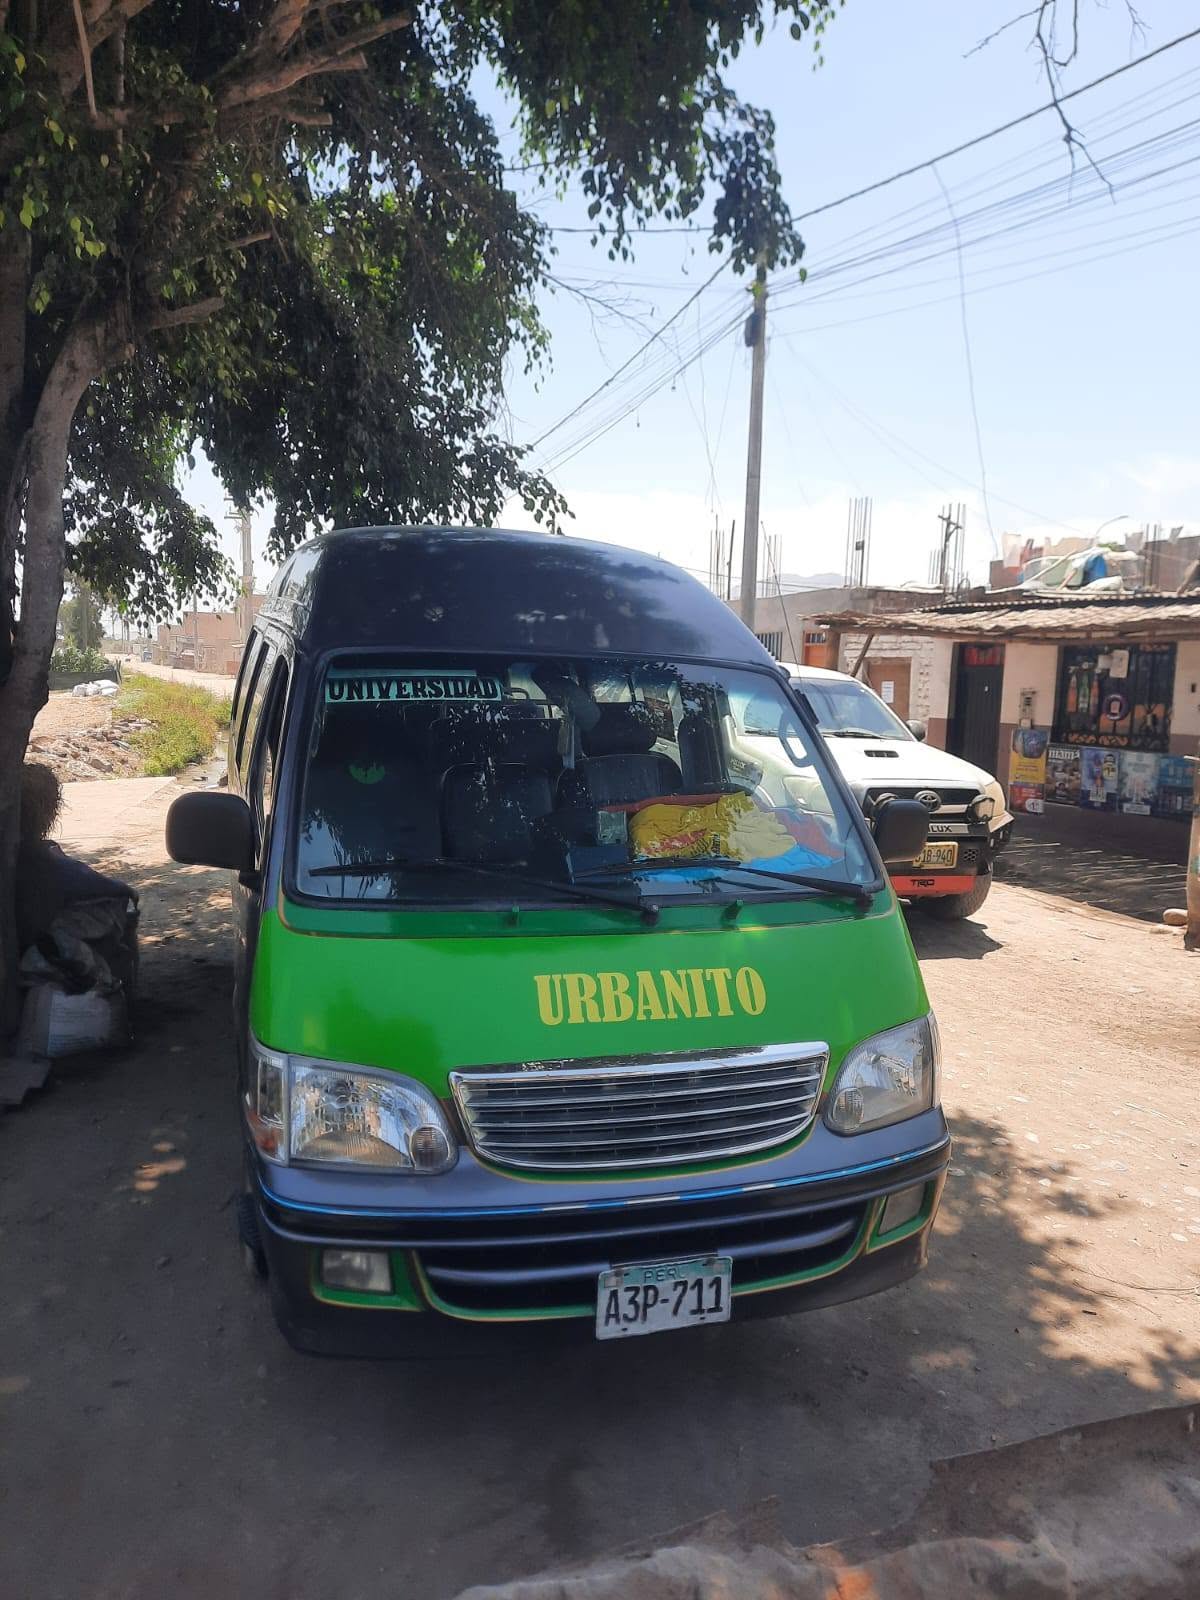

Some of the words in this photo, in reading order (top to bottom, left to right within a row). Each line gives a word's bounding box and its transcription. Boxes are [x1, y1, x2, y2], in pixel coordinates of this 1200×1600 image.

[328, 677, 498, 700] UNIVERSIDAD
[533, 966, 767, 1026] URBANITO
[604, 1276, 723, 1327] A3P-711
